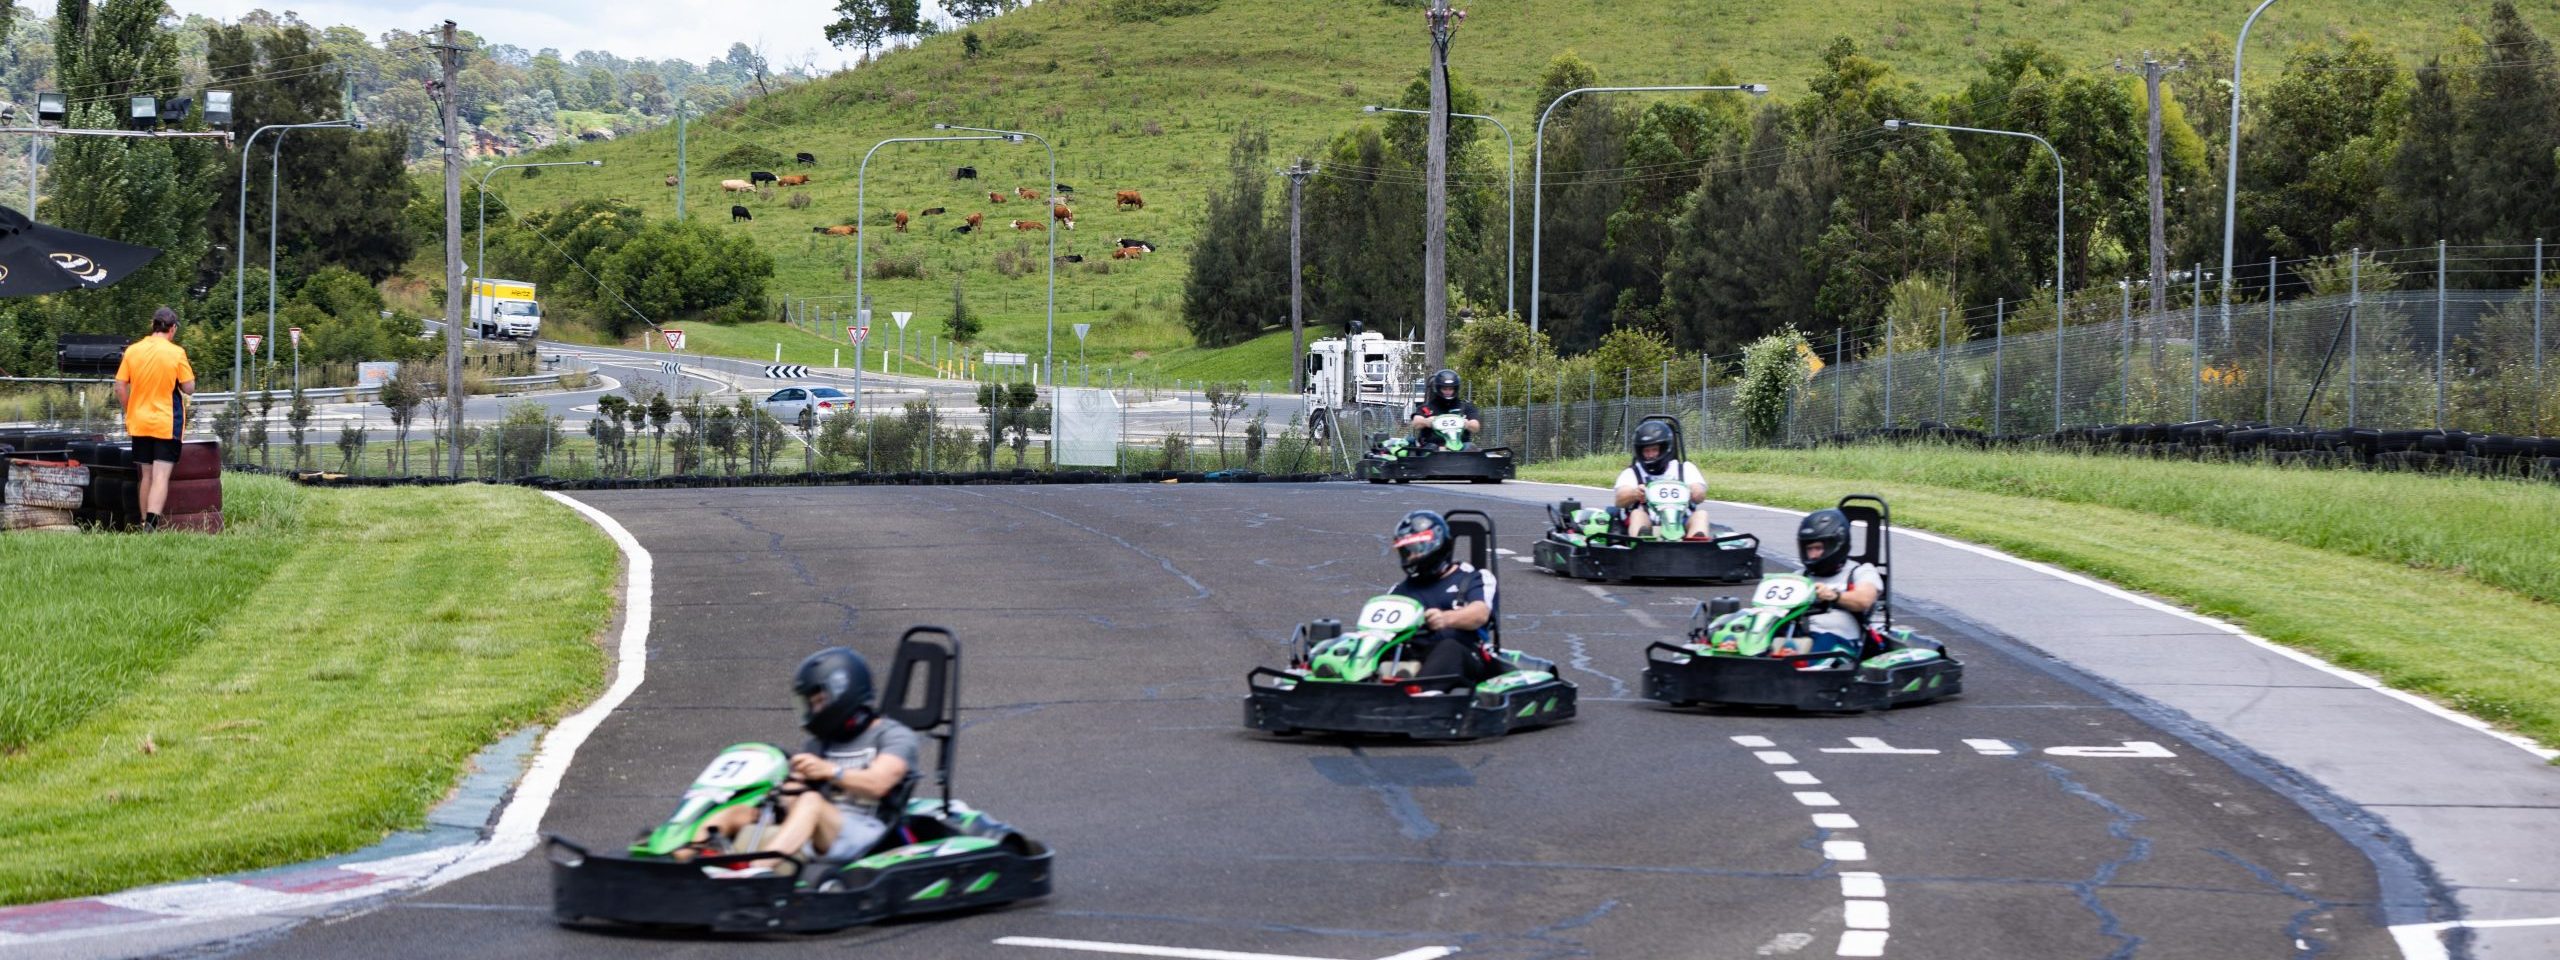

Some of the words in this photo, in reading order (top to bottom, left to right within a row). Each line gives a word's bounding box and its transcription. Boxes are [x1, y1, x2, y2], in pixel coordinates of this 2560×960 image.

[1442, 419, 1457, 427] 62
[1659, 487, 1680, 499] 66
[1765, 585, 1794, 600] 63
[1371, 608, 1402, 624] 60
[1819, 737, 2178, 757] PIT
